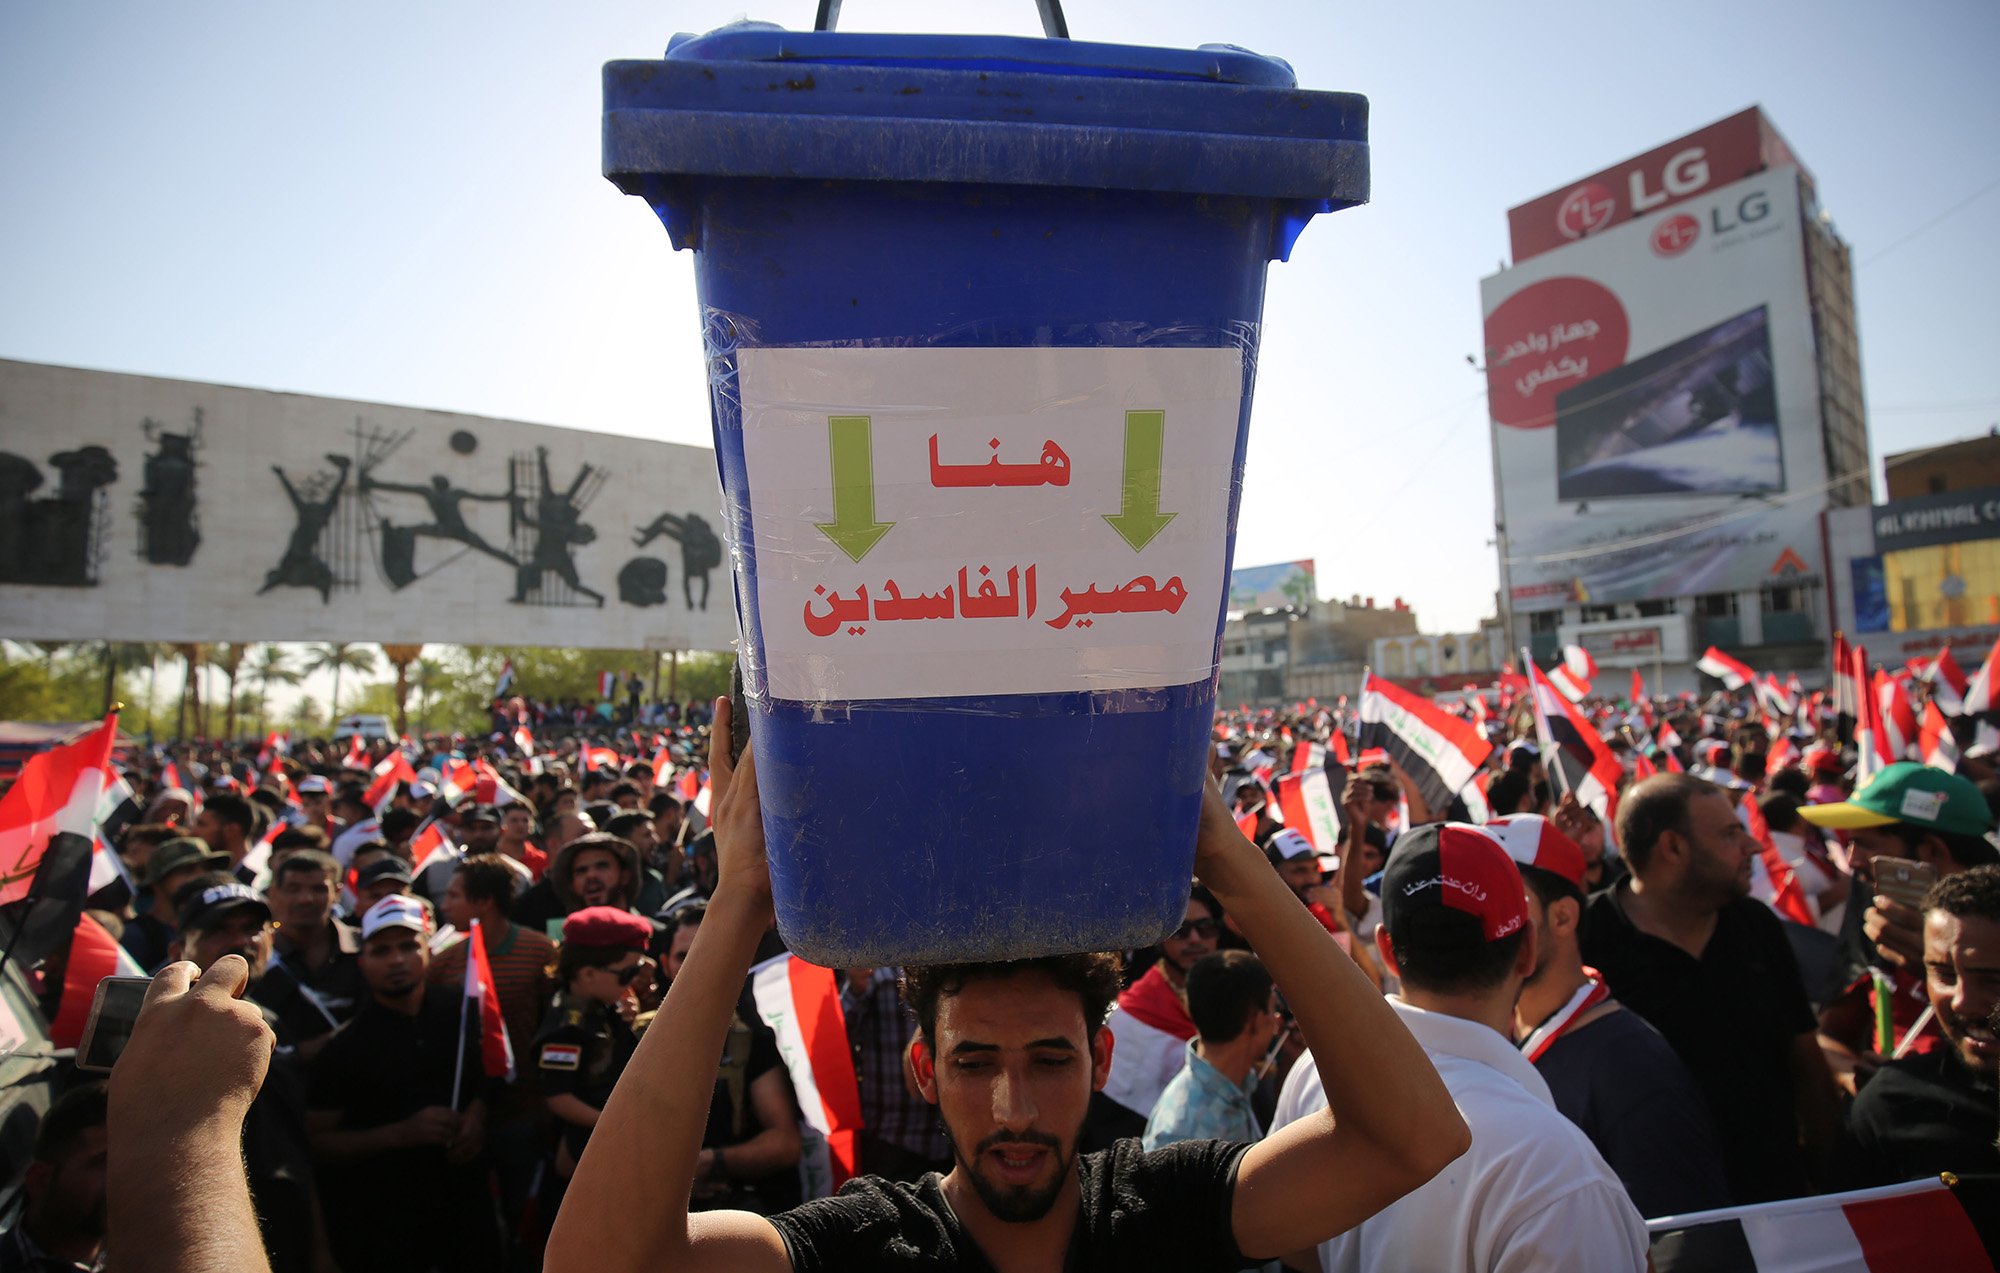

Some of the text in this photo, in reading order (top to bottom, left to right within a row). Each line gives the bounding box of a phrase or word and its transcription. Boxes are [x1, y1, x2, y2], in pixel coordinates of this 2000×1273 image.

[1628, 148, 1710, 212] LG
[1711, 190, 1770, 235] LG
[1503, 319, 1600, 362] جهاز واحد
[1515, 355, 1589, 398] يكفي
[928, 433, 1071, 488] هنا
[803, 563, 1189, 637] مصير الفاسدين
